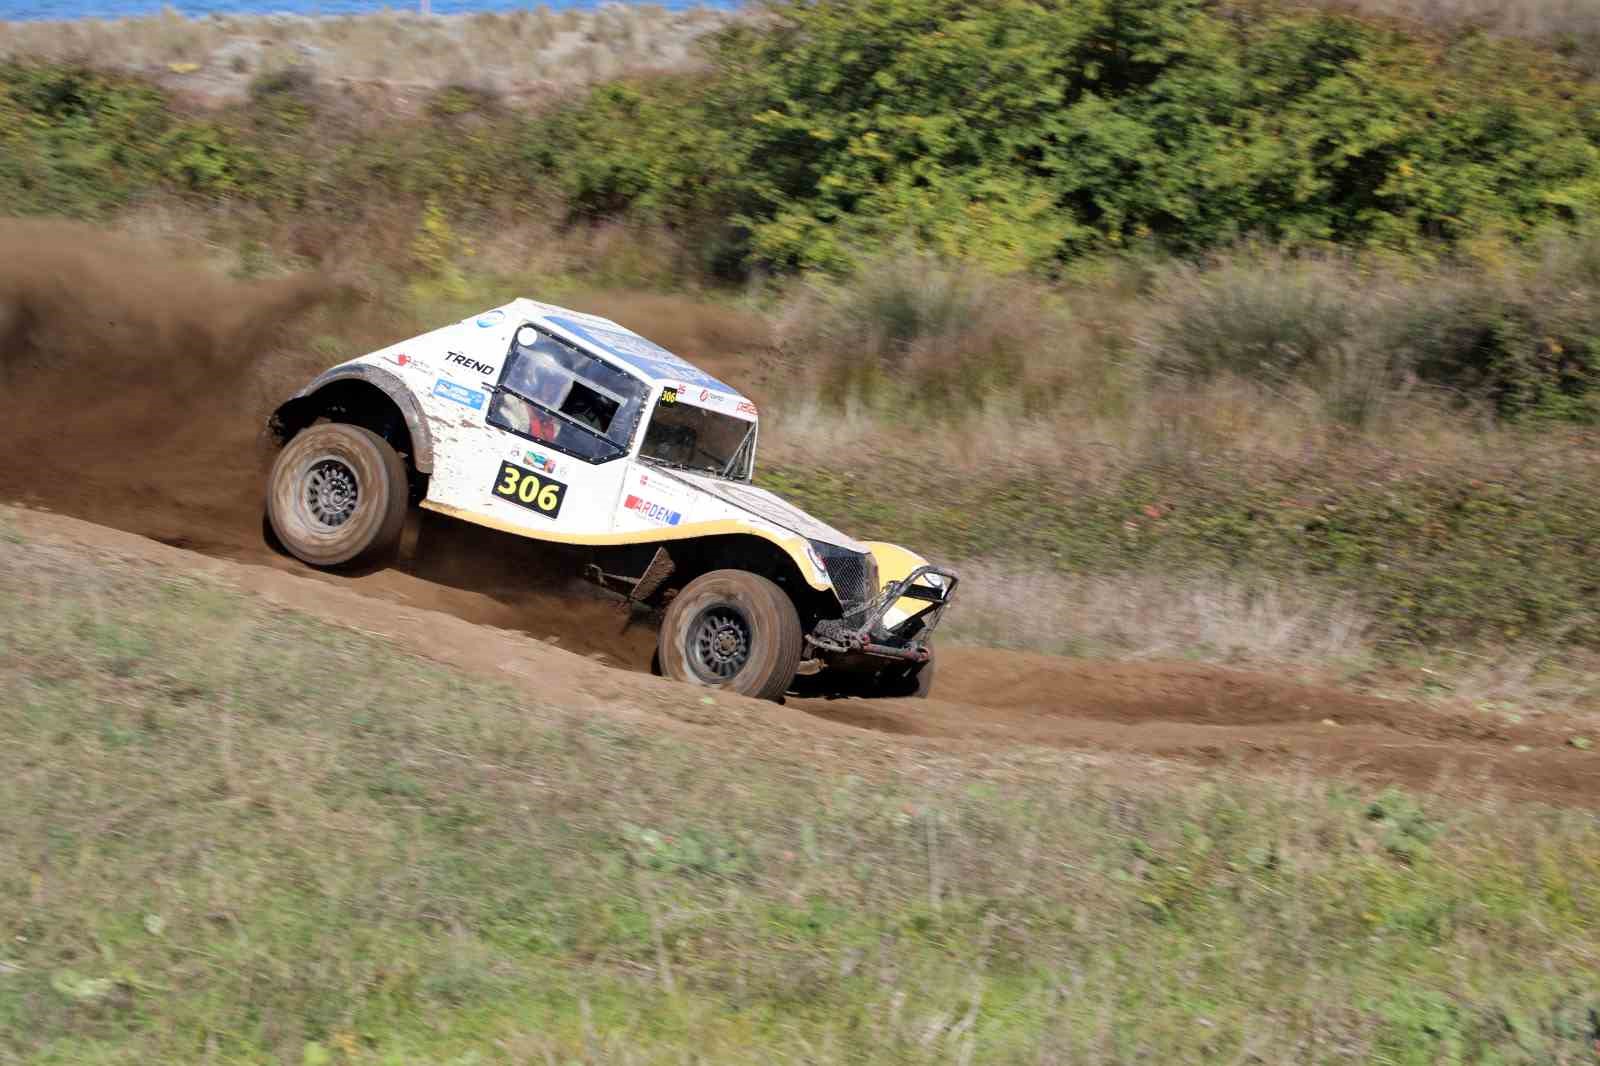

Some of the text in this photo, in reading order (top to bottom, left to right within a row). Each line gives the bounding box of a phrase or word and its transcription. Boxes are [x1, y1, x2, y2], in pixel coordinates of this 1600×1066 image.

[445, 351, 494, 375] TREND
[662, 390, 676, 403] 306
[497, 466, 560, 511] 306
[634, 497, 672, 523] ARDEN
